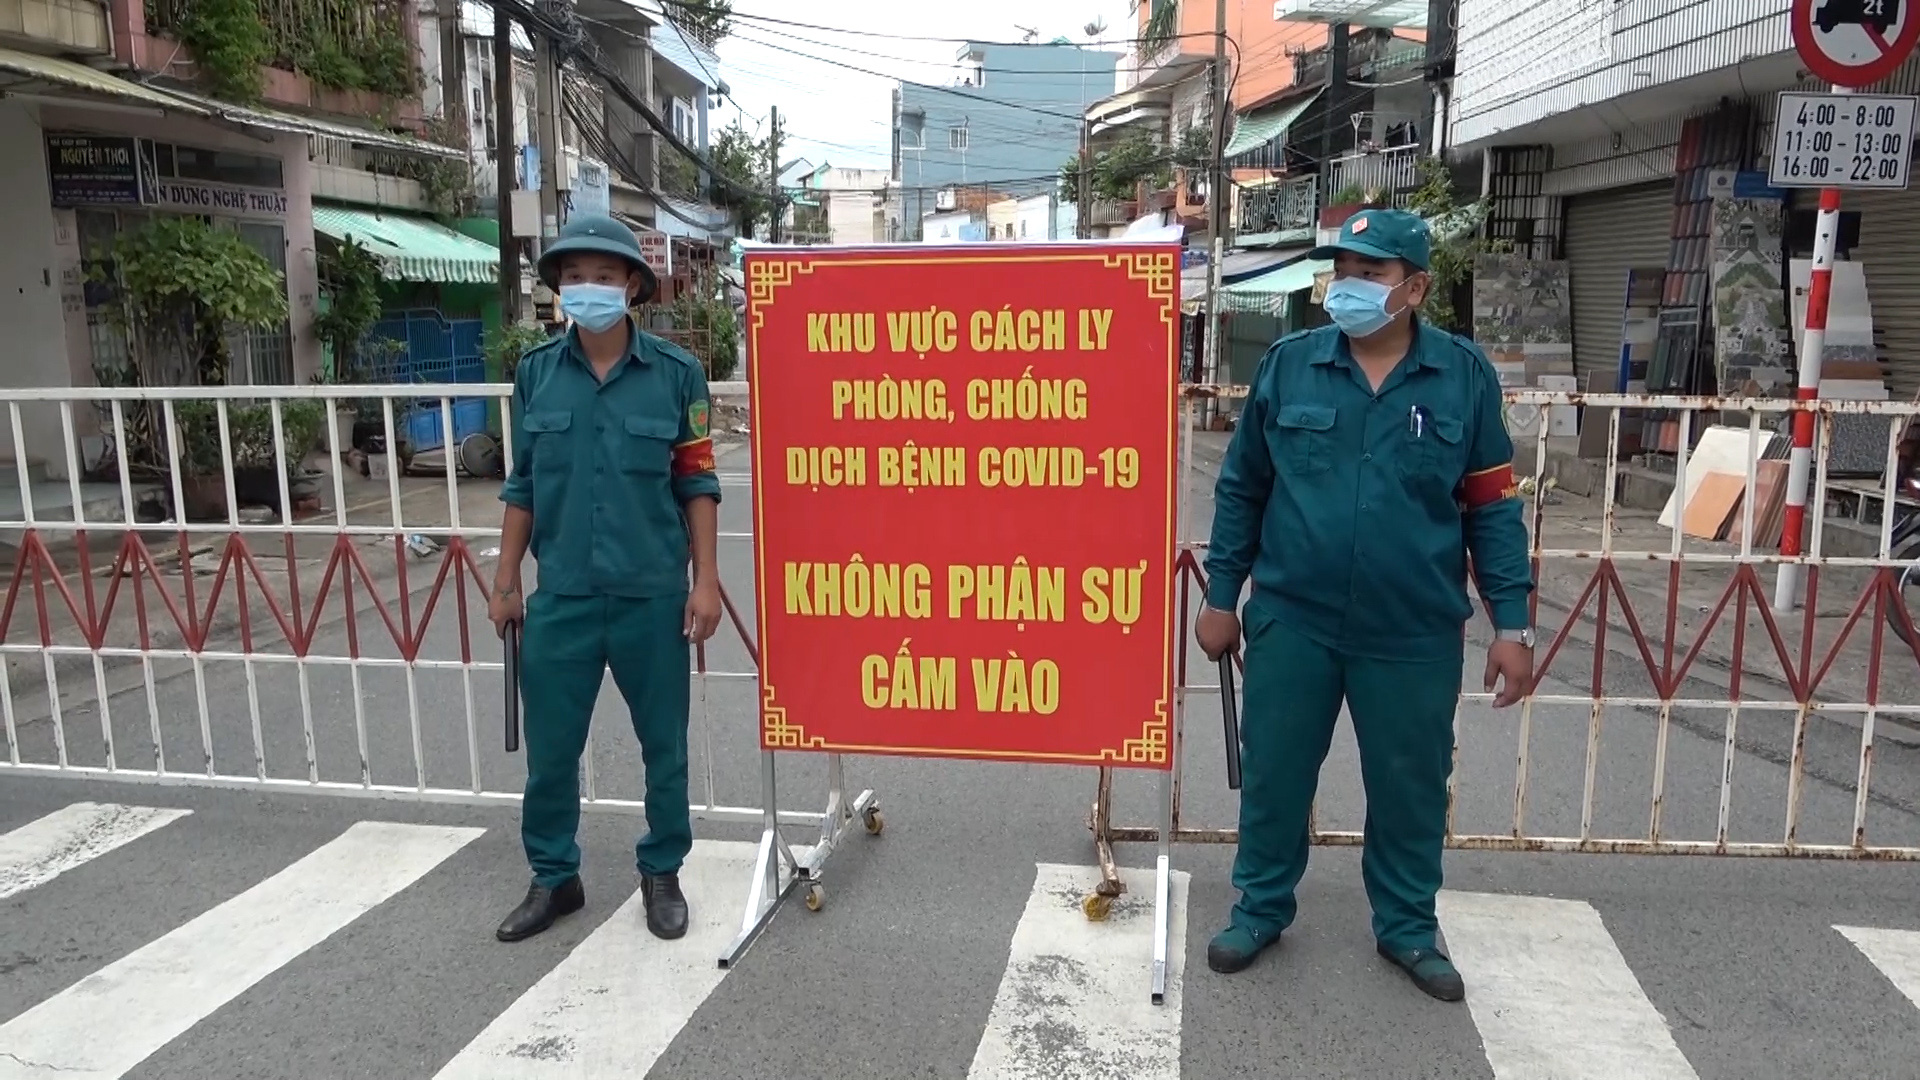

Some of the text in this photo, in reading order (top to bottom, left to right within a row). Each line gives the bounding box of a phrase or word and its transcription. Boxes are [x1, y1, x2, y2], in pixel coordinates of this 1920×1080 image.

[1863, 0, 1884, 15] 2t
[1796, 101, 1836, 127] 4:00
[1856, 105, 1895, 127] 8:00
[1785, 130, 1832, 152] 11:00
[1855, 132, 1901, 154] 13:00
[1783, 155, 1829, 178] 16:00
[1850, 155, 1898, 180] 22:00
[171, 185, 209, 206] DUNG
[212, 188, 248, 213] NGHỆ
[249, 191, 288, 215] THUẬT
[807, 305, 1113, 360] KHU VỰC CÁCH LY
[832, 365, 1088, 424] PHÒNG, CHỐNG
[786, 440, 1140, 493] DỊCH BỆNH COVID-19
[784, 553, 1147, 634] KHÔNG PHẬN SỰ
[861, 637, 1060, 715] CẤM VÀO
